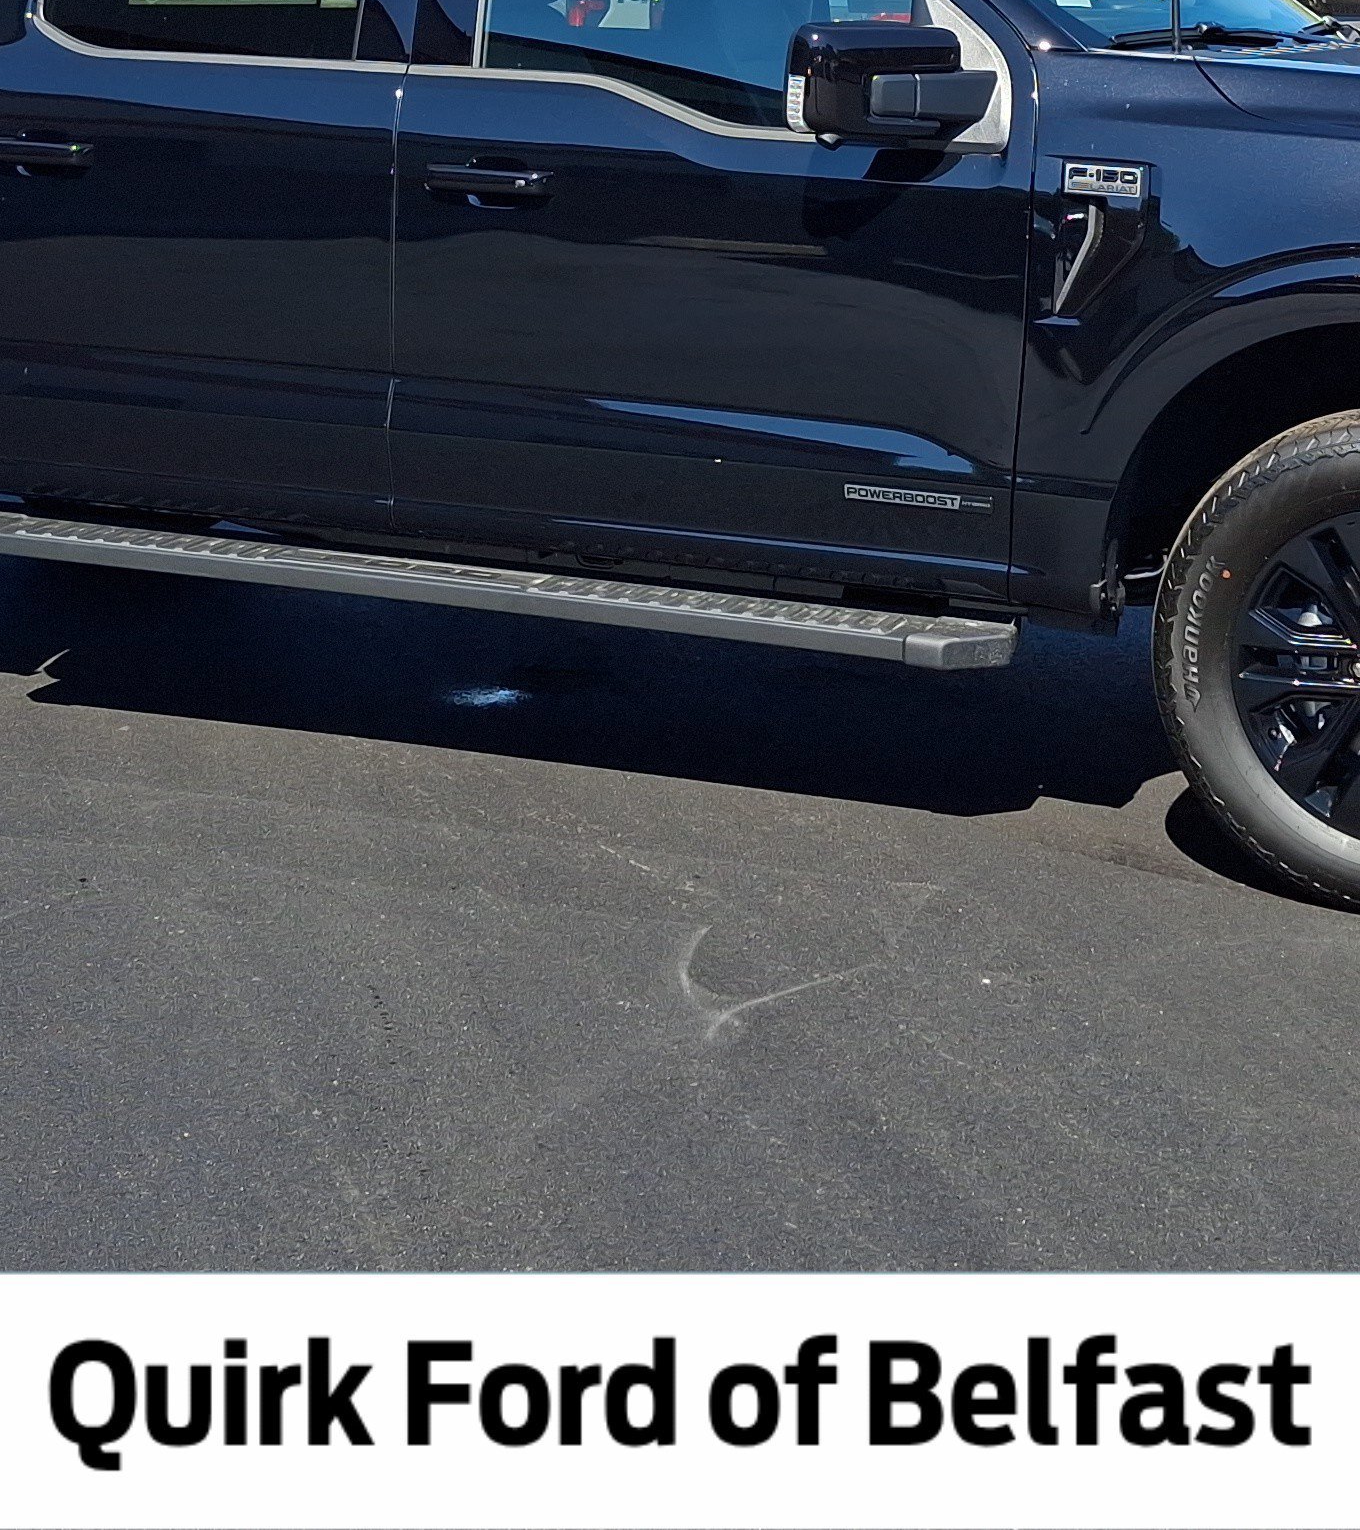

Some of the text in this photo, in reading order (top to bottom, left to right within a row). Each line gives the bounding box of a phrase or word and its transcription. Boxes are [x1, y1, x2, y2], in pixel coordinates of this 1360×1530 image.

[1068, 167, 1139, 184] F-150
[1090, 183, 1135, 193] LARIAT
[846, 486, 959, 508] POWERBOOST
